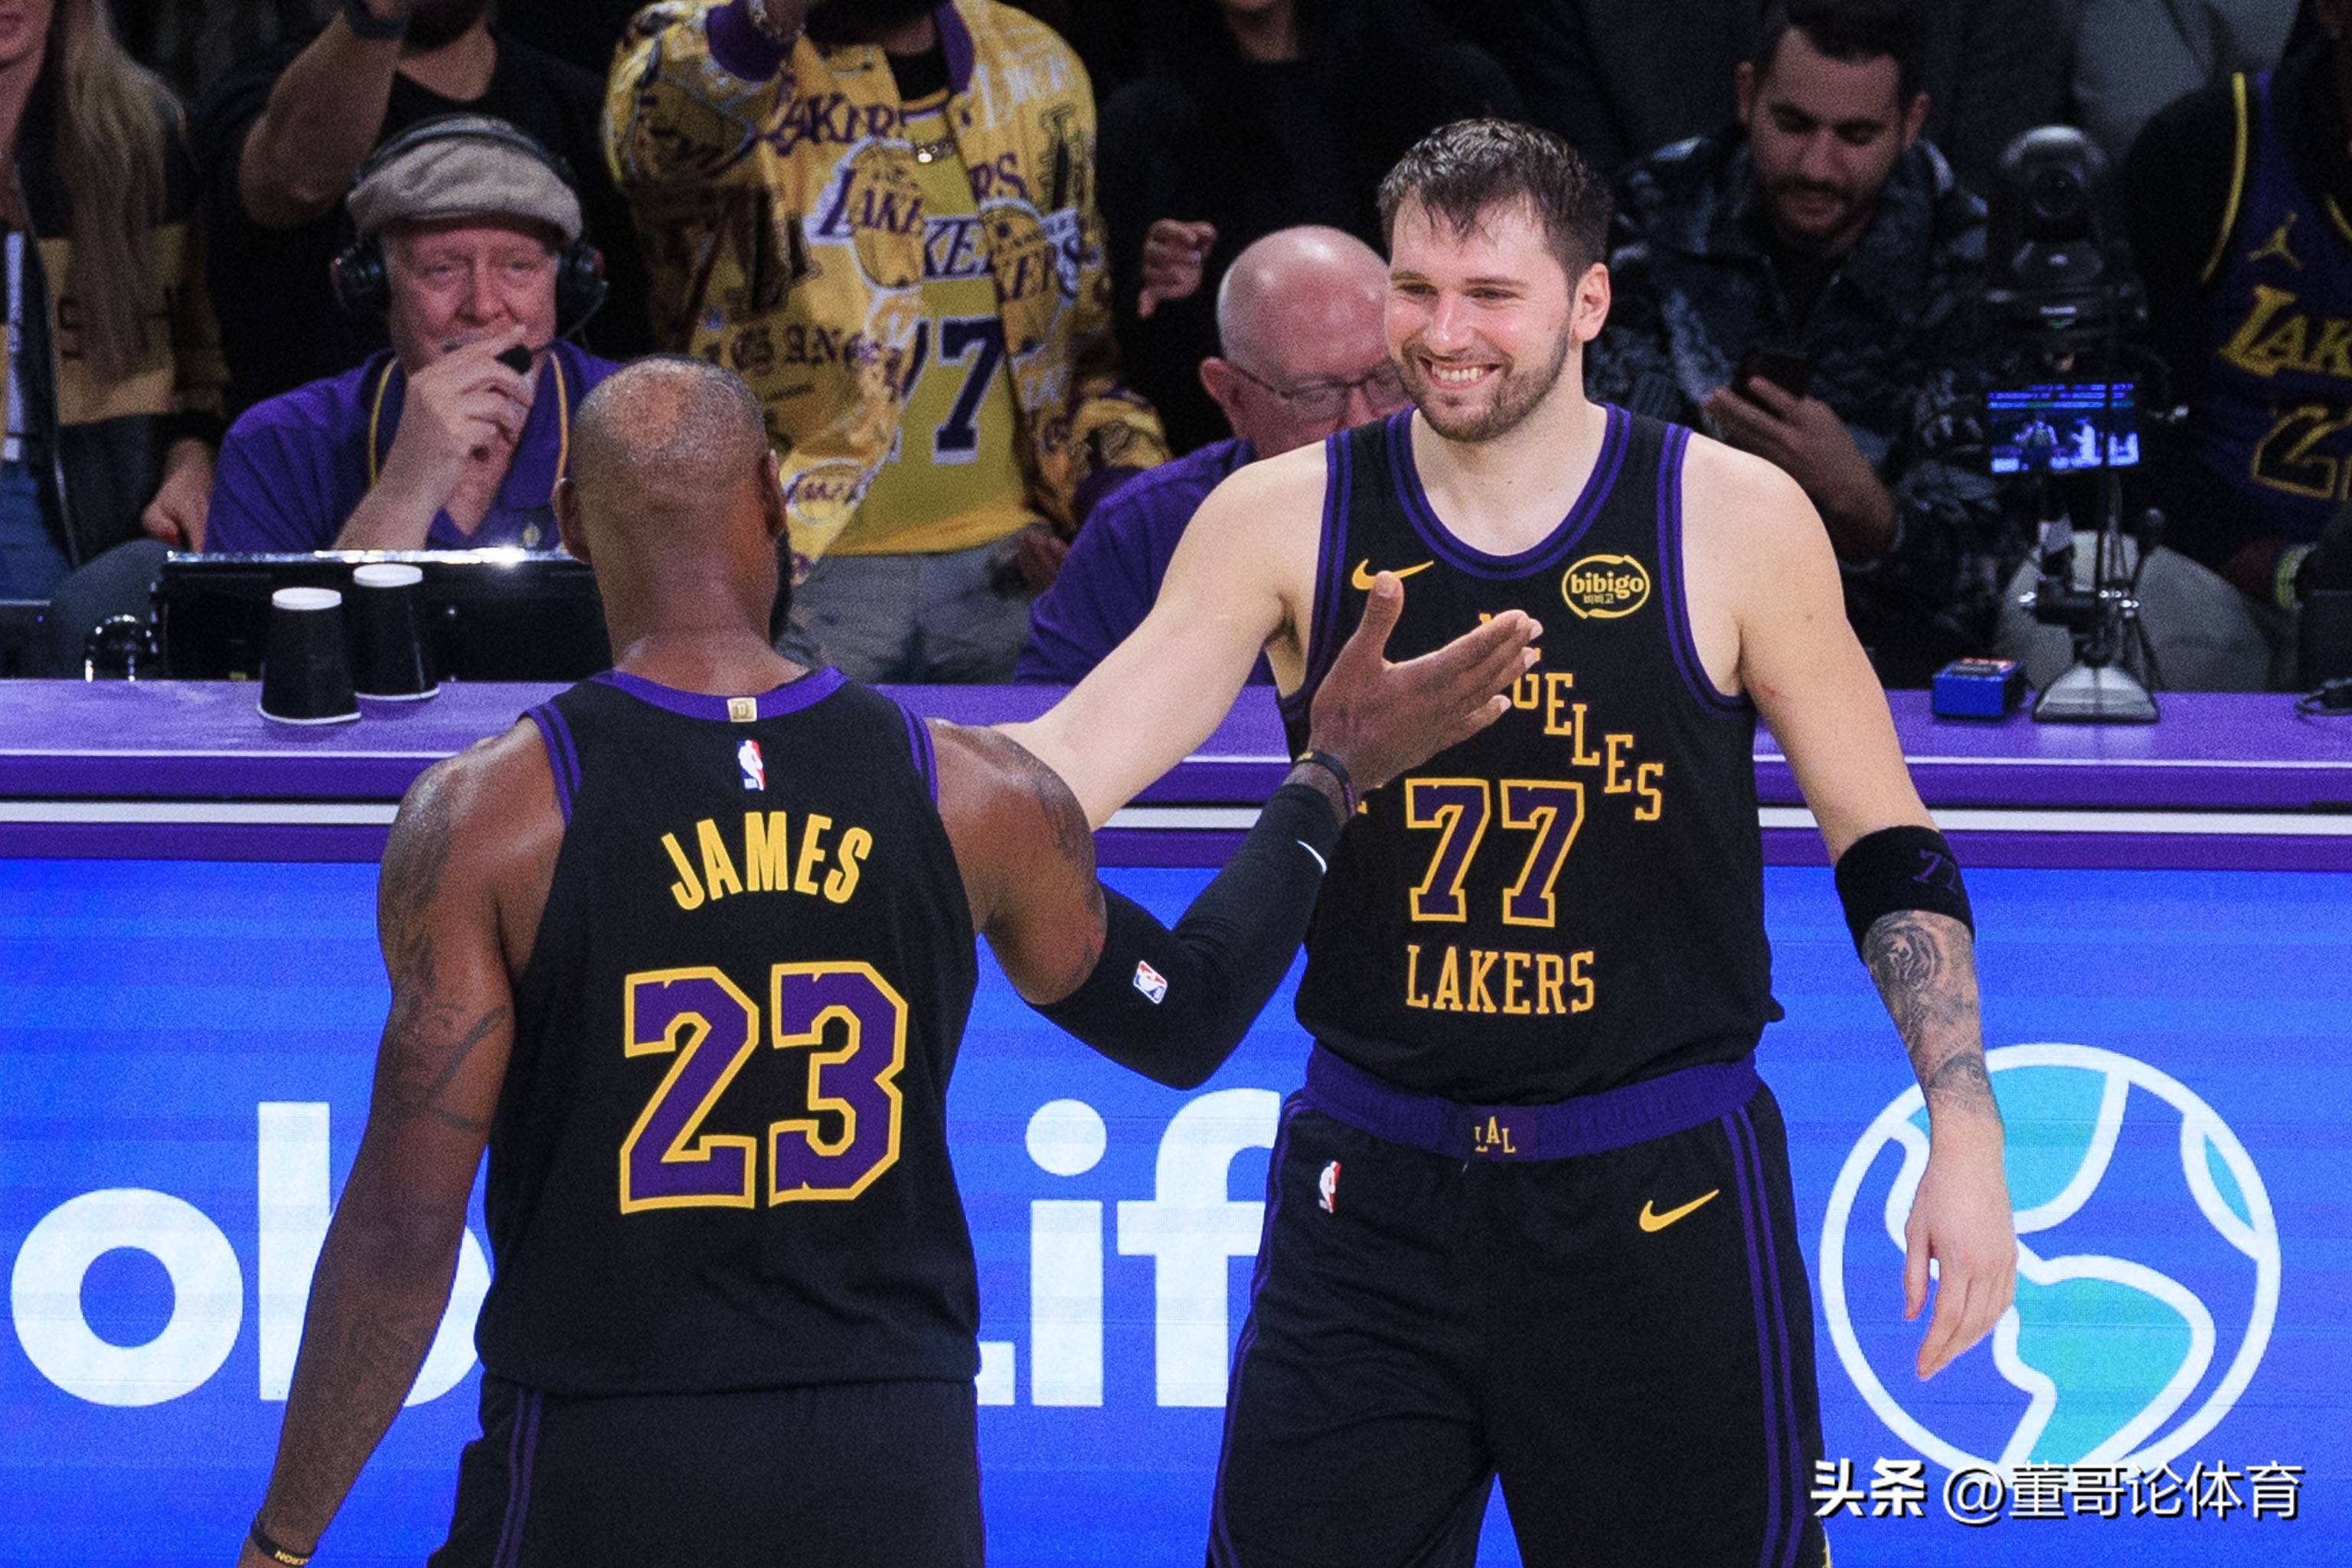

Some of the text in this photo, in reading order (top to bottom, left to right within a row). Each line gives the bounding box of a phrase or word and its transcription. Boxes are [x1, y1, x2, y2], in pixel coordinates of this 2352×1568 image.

[1571, 570, 1645, 599] bibigo
[661, 811, 873, 910] JAMES
[1405, 777, 1585, 927] 77
[1406, 944, 1595, 1015] LAKERS
[620, 961, 909, 1215] 23
[1474, 1116, 1517, 1154] LAL
